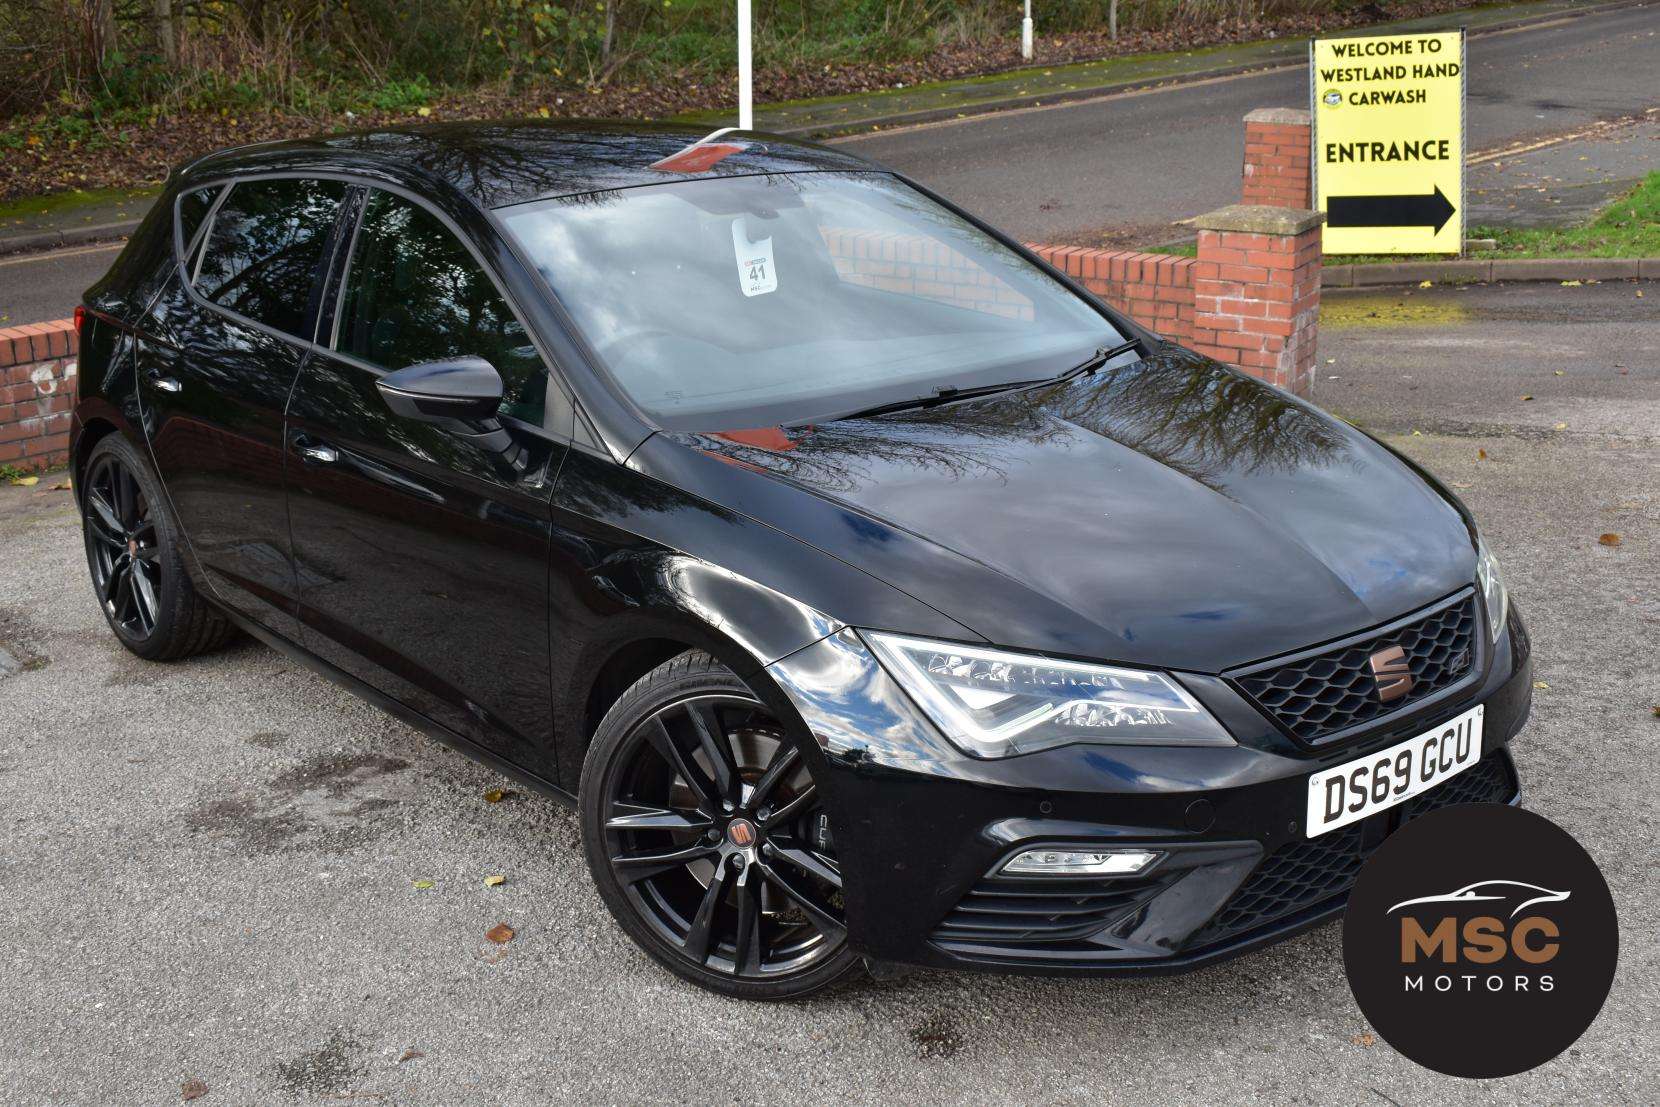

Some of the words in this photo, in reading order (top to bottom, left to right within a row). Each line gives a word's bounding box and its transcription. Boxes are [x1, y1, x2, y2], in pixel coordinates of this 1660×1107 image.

[1332, 40, 1412, 57] WELCOME
[1418, 39, 1442, 54] TO
[1321, 66, 1407, 82] WESTLAND
[1412, 63, 1460, 78] HAND
[1349, 89, 1426, 105] CARWASH
[1326, 140, 1449, 163] ENTRANCE
[749, 264, 766, 281] 41
[1323, 749, 1412, 824] DS69
[1420, 717, 1473, 783] GCU
